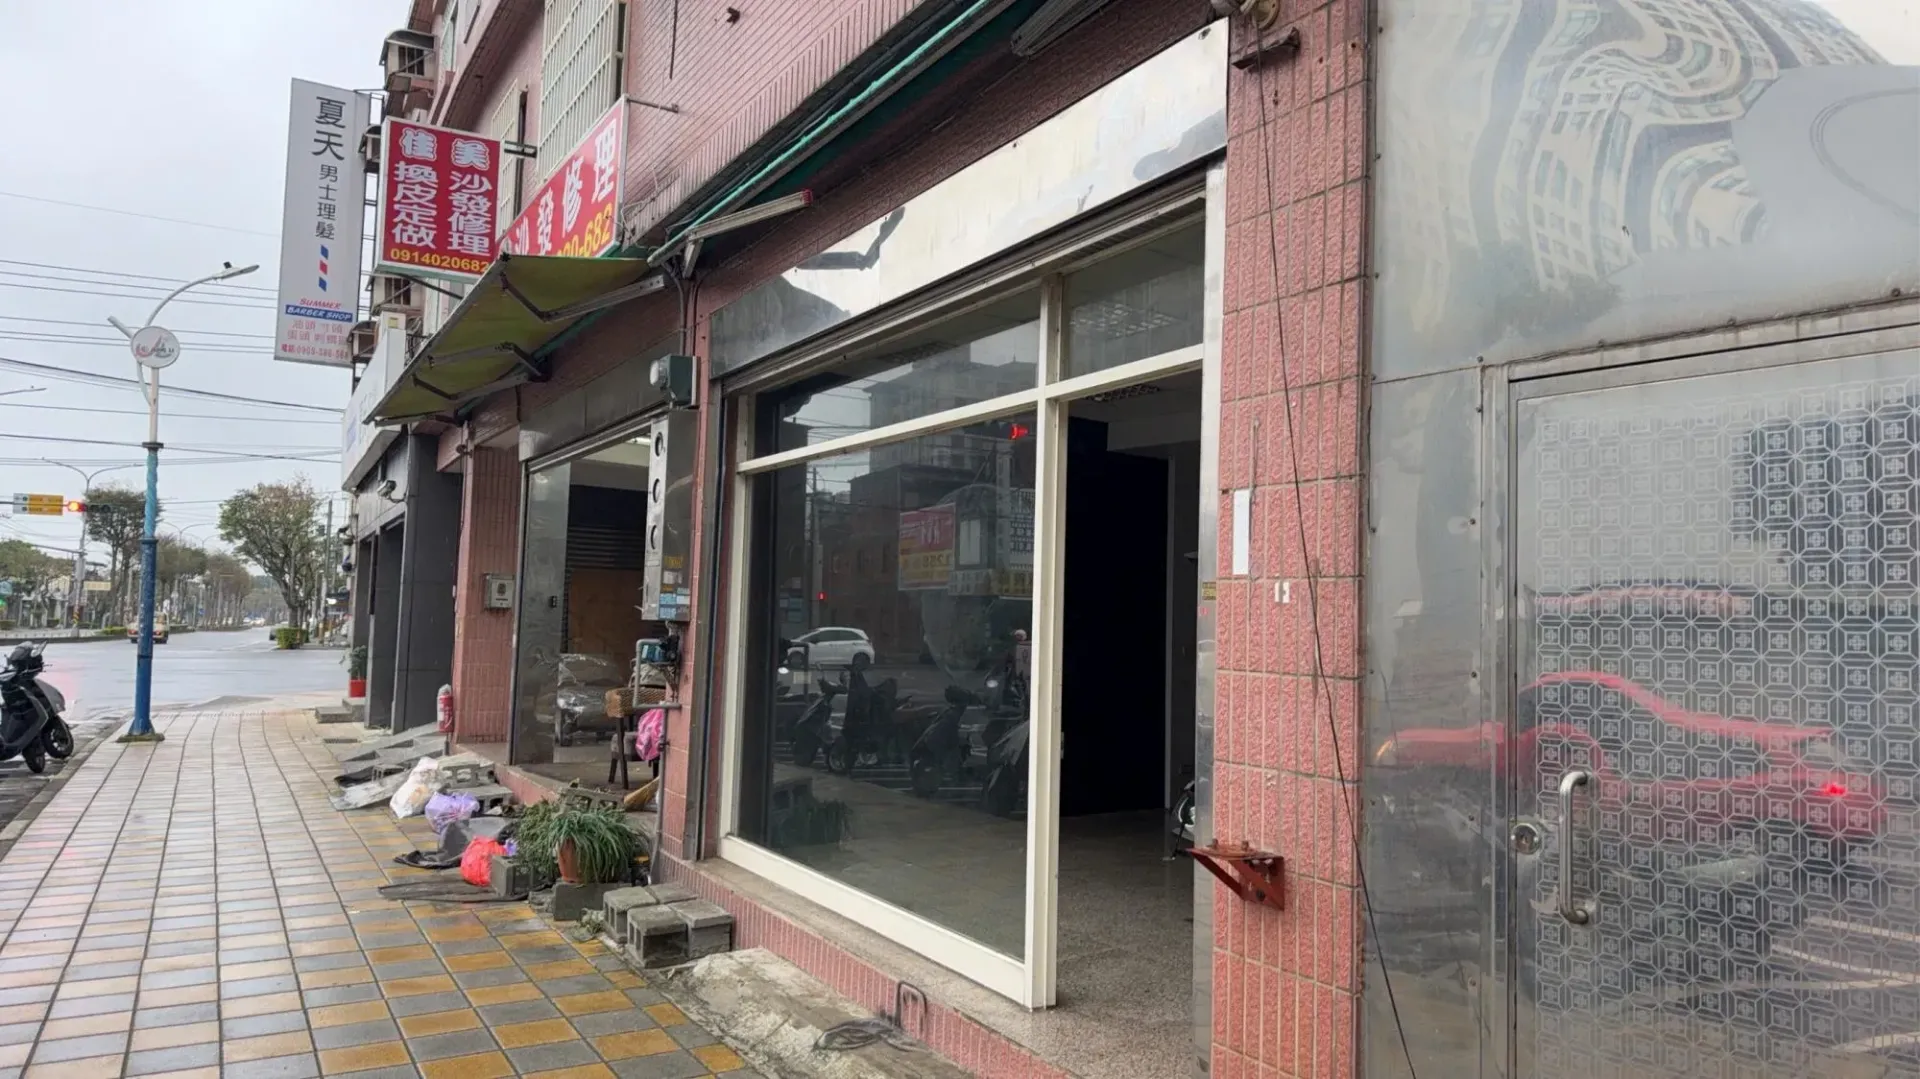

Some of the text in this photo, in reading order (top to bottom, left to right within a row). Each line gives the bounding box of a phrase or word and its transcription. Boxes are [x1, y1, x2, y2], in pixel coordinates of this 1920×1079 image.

[312, 96, 346, 161] 夏天
[315, 164, 338, 241] 男士理髮
[391, 161, 439, 250] 換皮定做
[446, 171, 492, 257] 沙發修理
[498, 119, 618, 258] 沙發修理
[390, 247, 489, 273] 0914020682
[287, 307, 351, 321] BARBER SHOP
[300, 298, 342, 309] SUMMER
